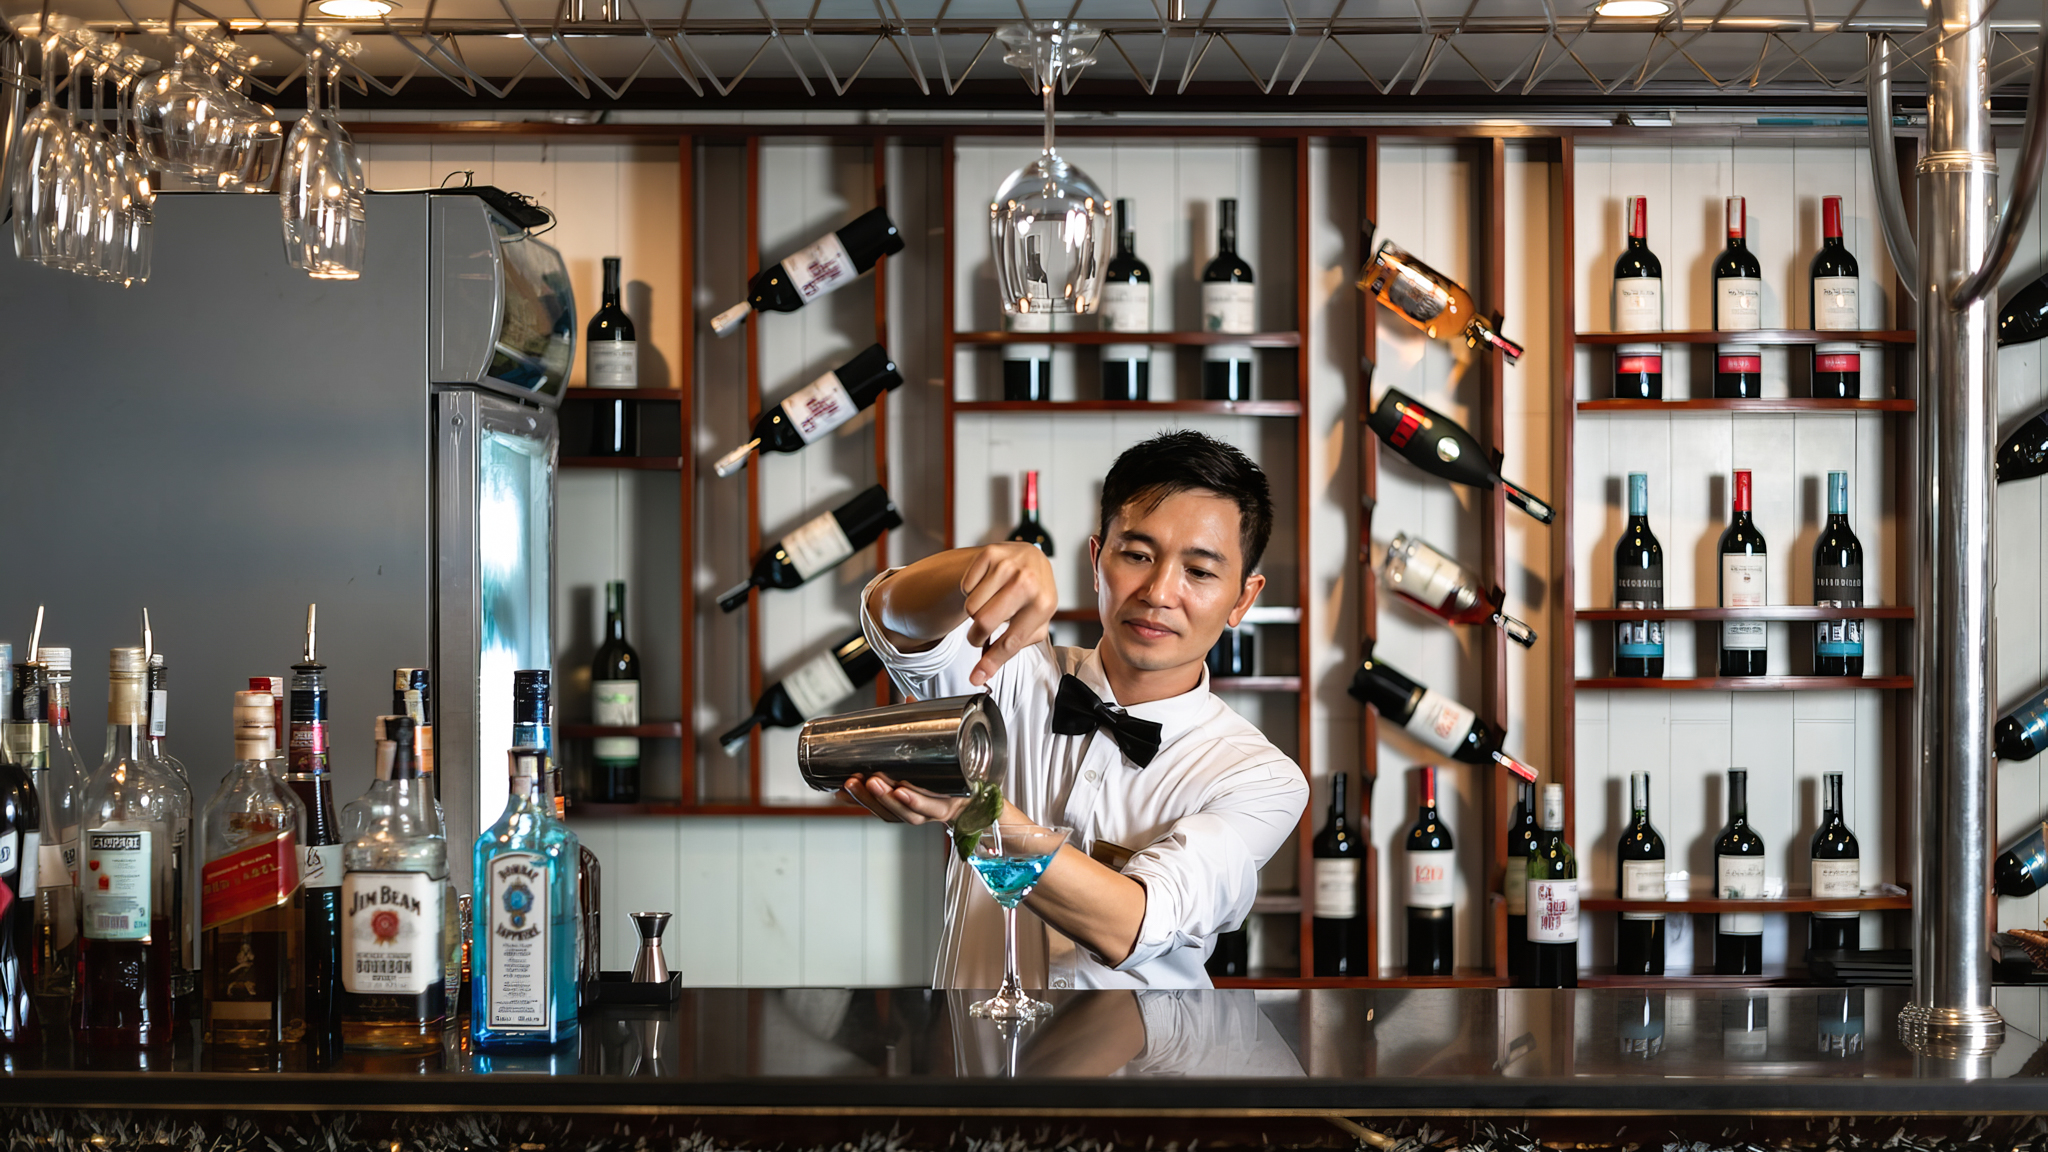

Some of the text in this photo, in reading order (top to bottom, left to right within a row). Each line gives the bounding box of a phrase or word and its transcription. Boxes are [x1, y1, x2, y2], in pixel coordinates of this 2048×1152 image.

[349, 885, 421, 917] JIM BEAM
[356, 959, 412, 974] BOURBON
